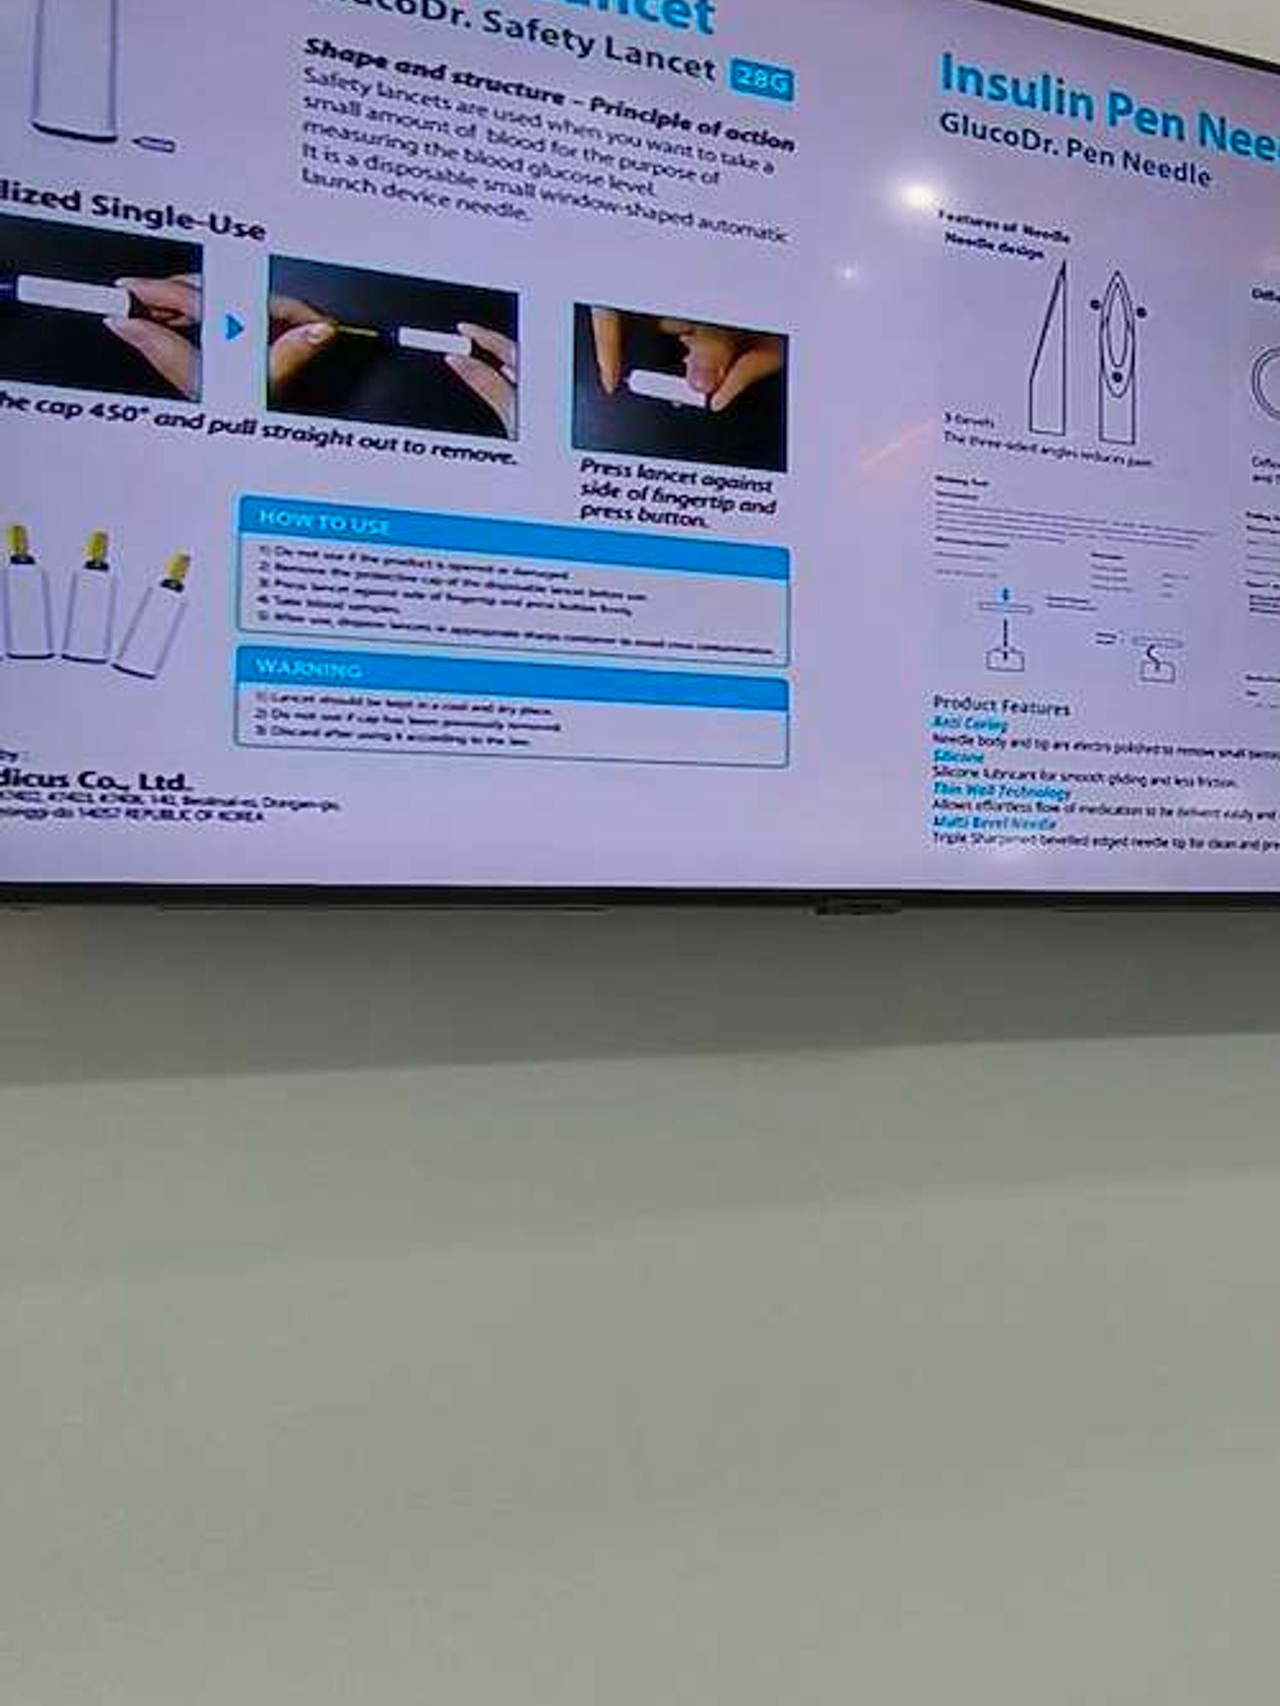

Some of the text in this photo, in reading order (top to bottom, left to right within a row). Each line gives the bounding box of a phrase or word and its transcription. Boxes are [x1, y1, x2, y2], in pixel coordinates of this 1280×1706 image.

[484, 10, 596, 60] Safety
[606, 36, 716, 81] Lancet
[737, 67, 789, 94] 28G
[304, 36, 796, 153] Shape and structure Principle of action
[941, 52, 1096, 122] Insulin
[1107, 89, 1185, 143] Pen
[304, 66, 775, 175] Safety lancets are used when you want to take a
[302, 120, 419, 157] measuring
[423, 142, 459, 162] the
[463, 148, 524, 173] blood
[527, 158, 604, 188] glucose
[303, 95, 721, 185] small amount of blood for the purpose of
[939, 110, 1213, 189] GlucoDr. Pen Needle
[302, 144, 318, 161] It
[324, 150, 340, 164] is
[345, 153, 359, 167] a
[364, 154, 478, 190] disposable
[482, 178, 536, 199] small
[698, 215, 790, 244] automatic
[382, 182, 450, 209] device
[91, 193, 267, 241] Single-Use
[1022, 224, 1070, 245] Needle
[944, 230, 1045, 261] Needle design
[35, 399, 83, 419] cap
[154, 414, 205, 430] and
[207, 418, 256, 436] pull
[262, 423, 354, 448] straight
[357, 435, 398, 452] out
[403, 440, 427, 456] to
[430, 445, 519, 466] remove.
[945, 431, 965, 443] The
[580, 456, 772, 494] Press lancet against
[580, 480, 777, 515] side of fingertip and
[580, 504, 633, 520] press
[258, 507, 391, 537] HOW TO USE
[255, 657, 363, 679] WARNING
[934, 695, 1070, 717] Product Features
[1000, 784, 1070, 802] Technology
[1060, 771, 1103, 783] smooth
[1151, 775, 1171, 785] and
